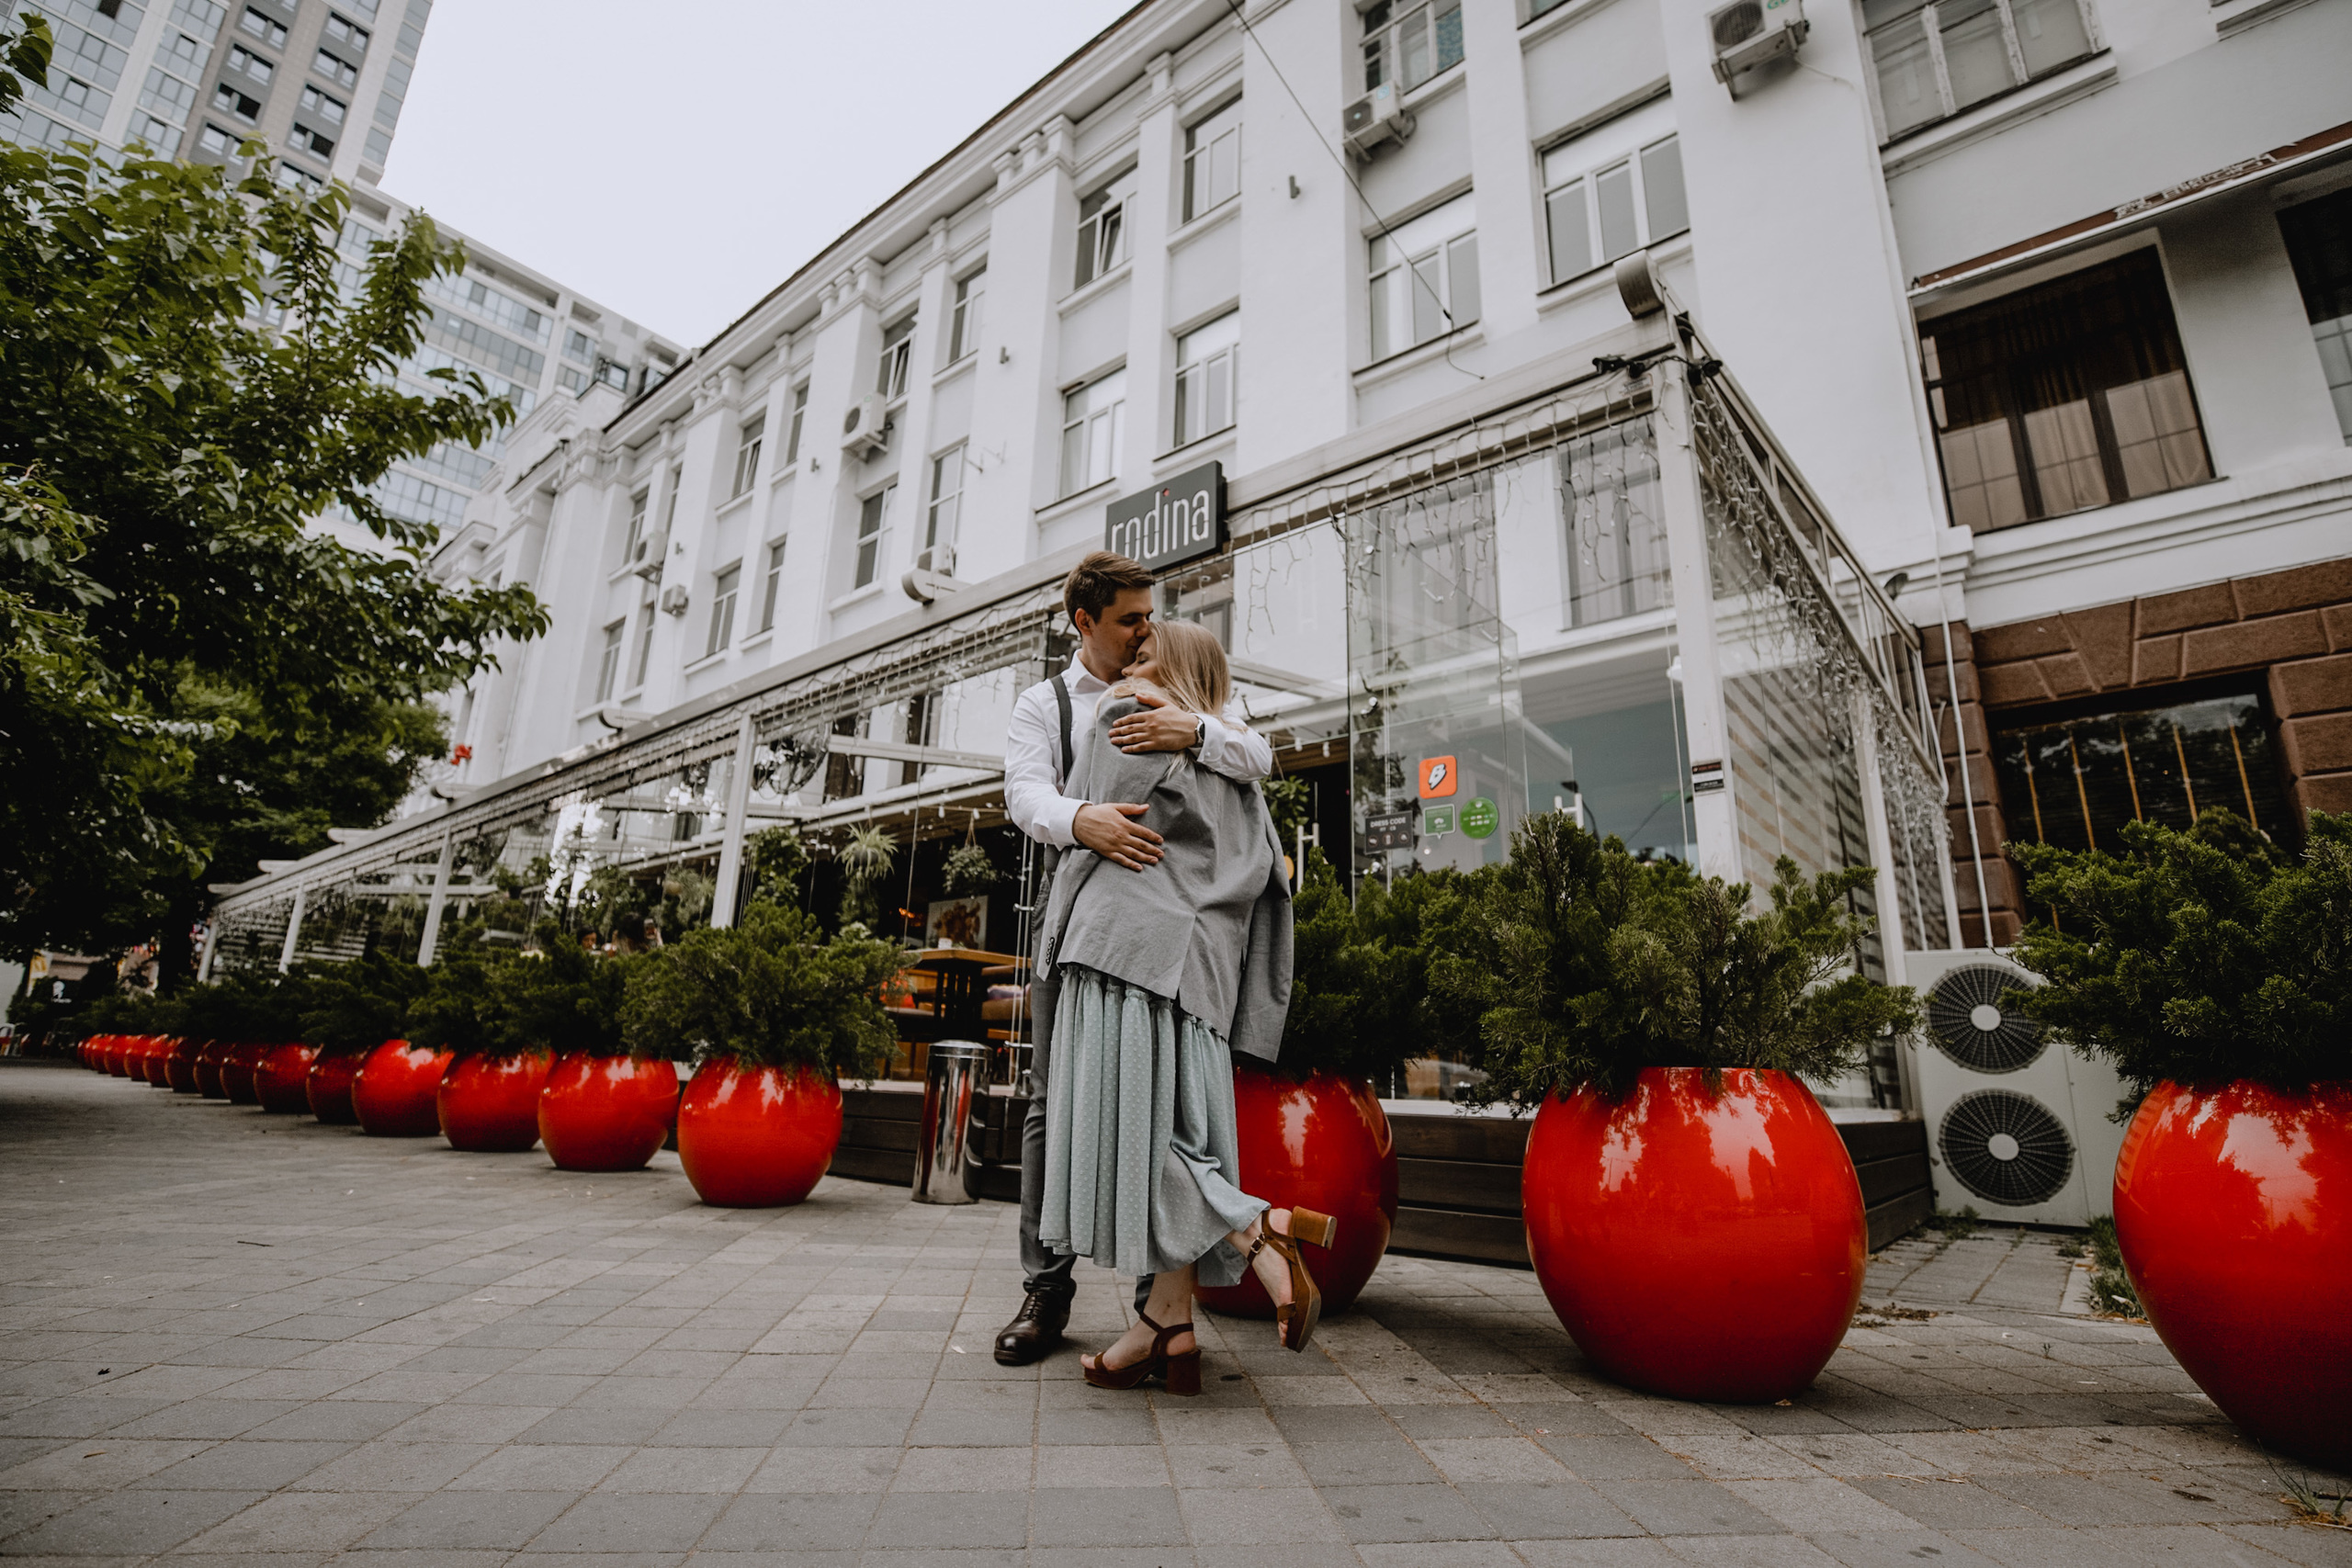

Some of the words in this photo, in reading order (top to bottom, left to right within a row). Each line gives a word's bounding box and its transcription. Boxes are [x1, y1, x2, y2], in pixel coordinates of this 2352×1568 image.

[1111, 488, 1210, 561] rodina
[1370, 819, 1388, 828] DRESS
[1389, 817, 1406, 825] CODE
